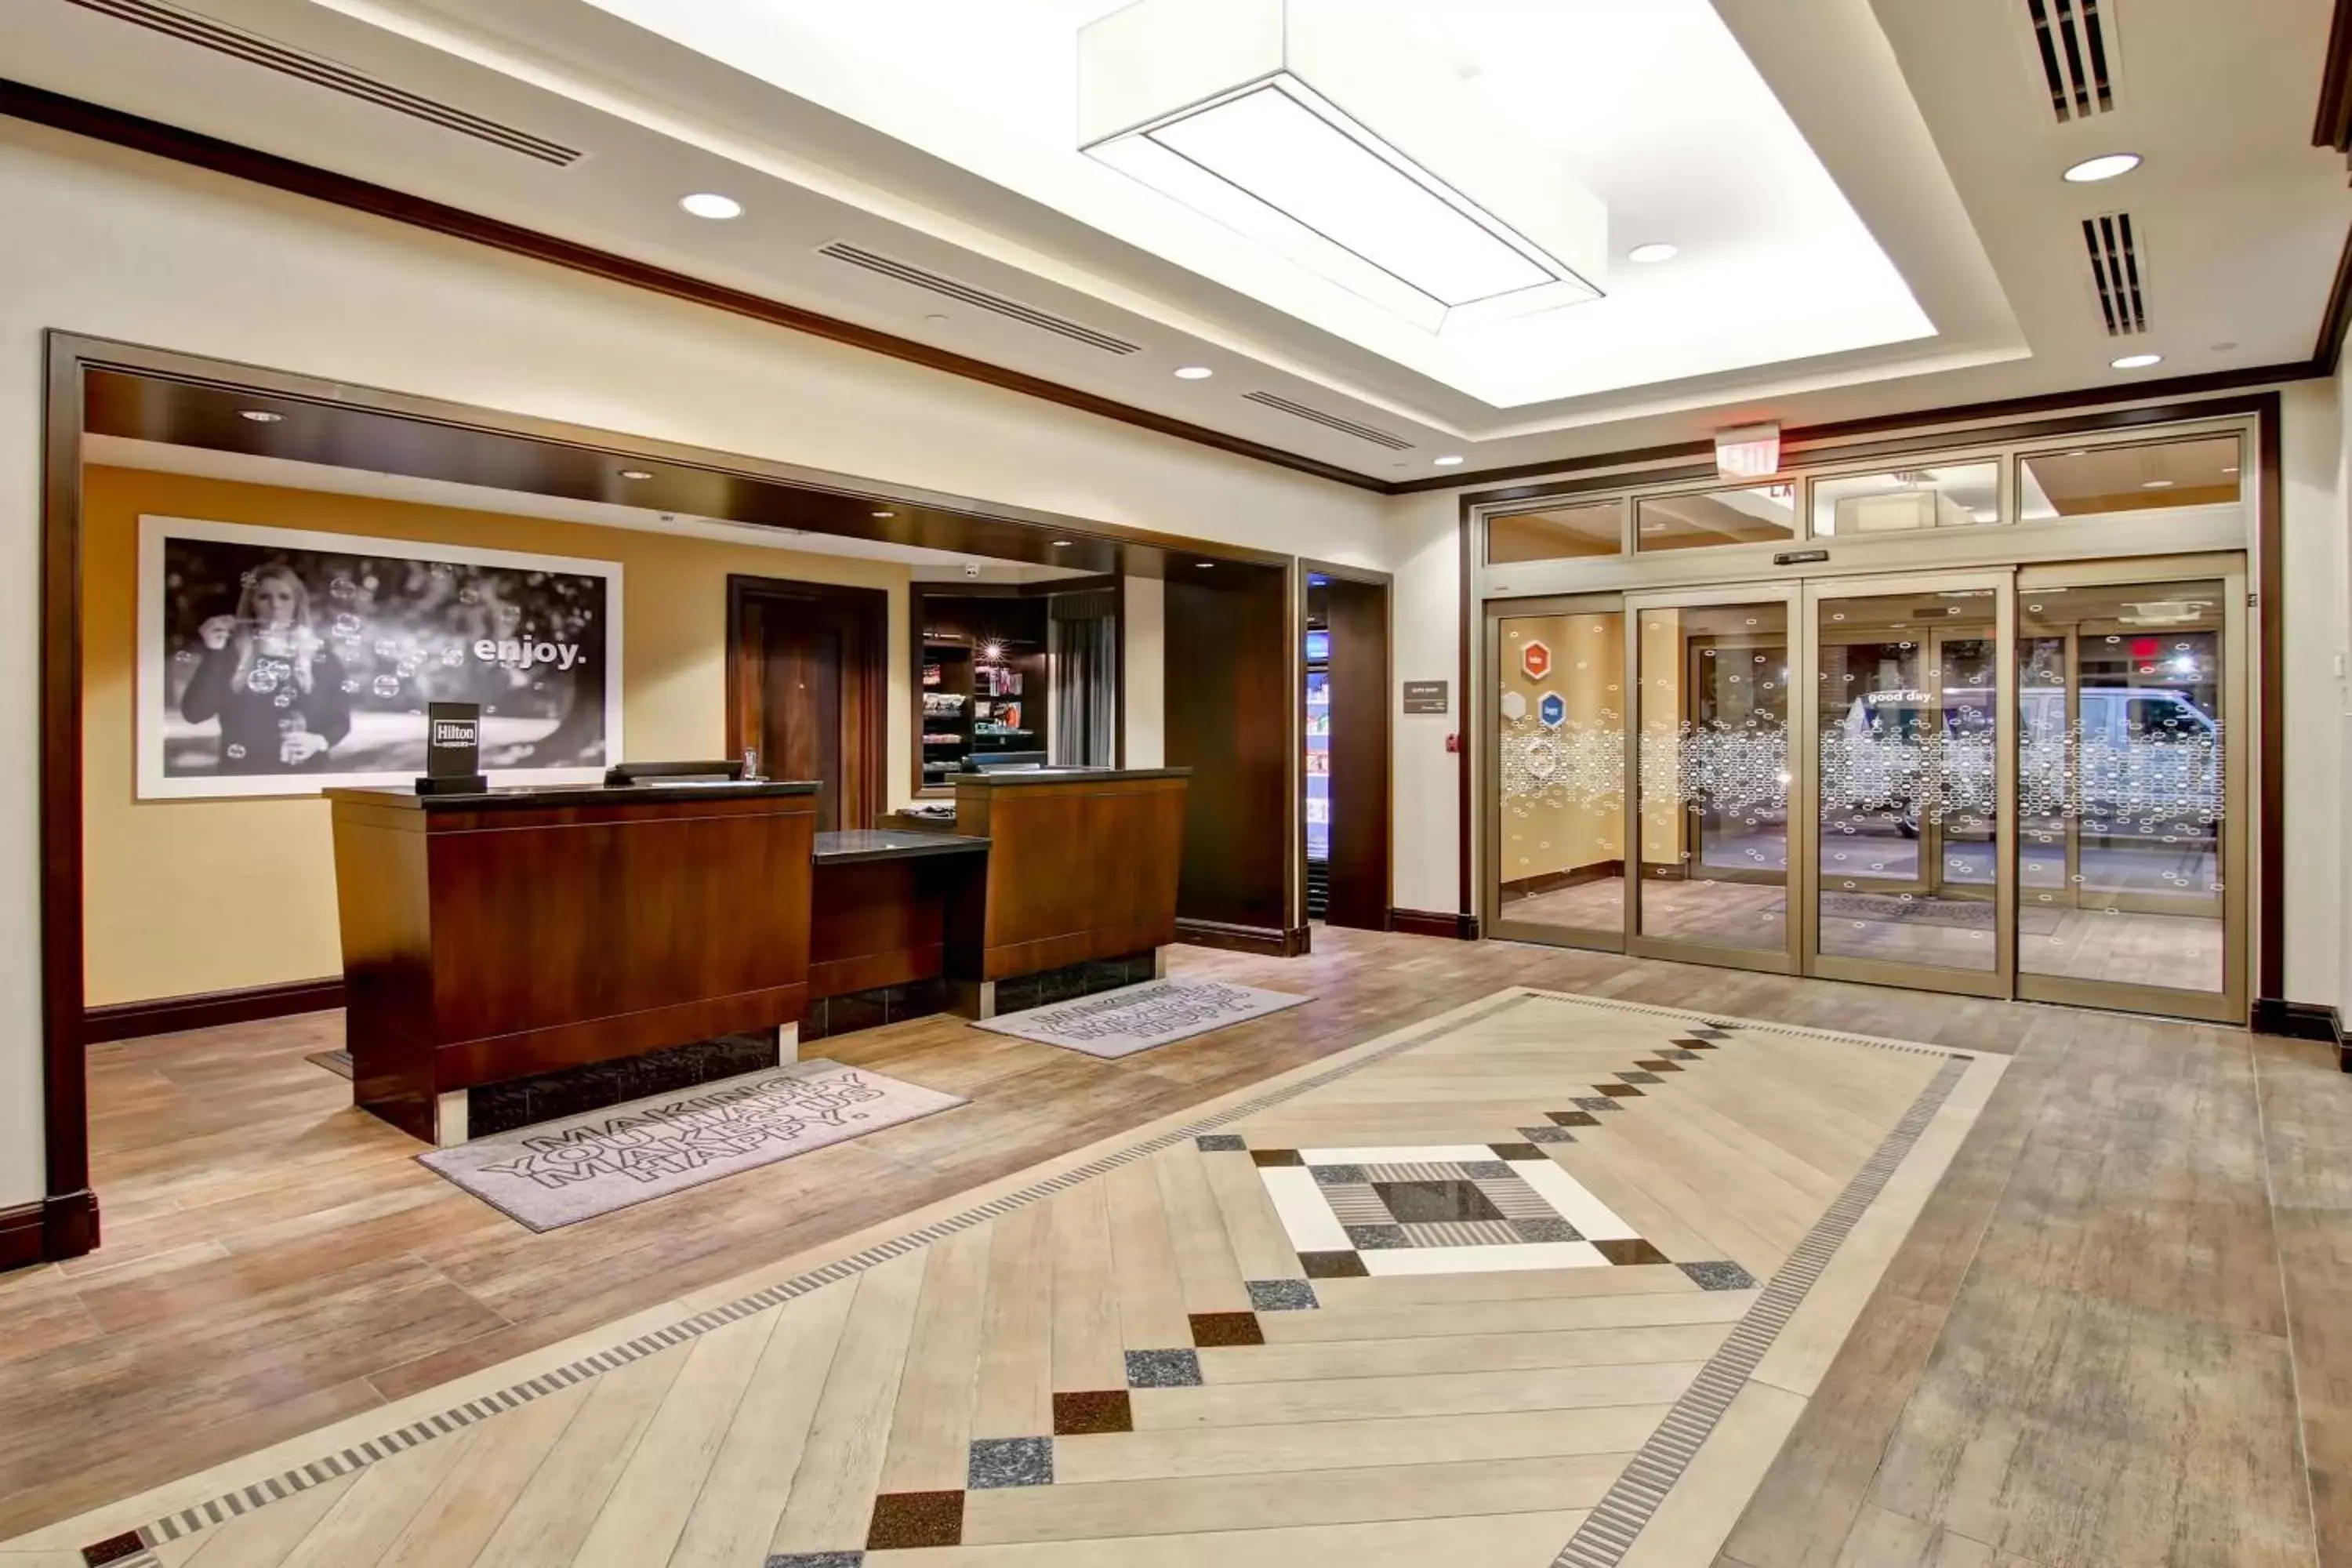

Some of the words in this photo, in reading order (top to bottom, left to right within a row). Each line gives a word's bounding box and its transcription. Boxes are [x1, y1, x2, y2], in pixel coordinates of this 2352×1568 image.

[474, 634, 586, 670] enjoy.
[437, 724, 474, 739] Hilton
[1868, 692, 1902, 703] good
[1906, 692, 1935, 703] day.
[477, 1128, 656, 1177] YOU
[673, 1073, 868, 1131] HAPPY
[521, 1076, 809, 1152] MAKING
[531, 1109, 797, 1189] MAKES
[795, 1087, 885, 1112] US
[626, 1109, 868, 1183] HAPPY.
